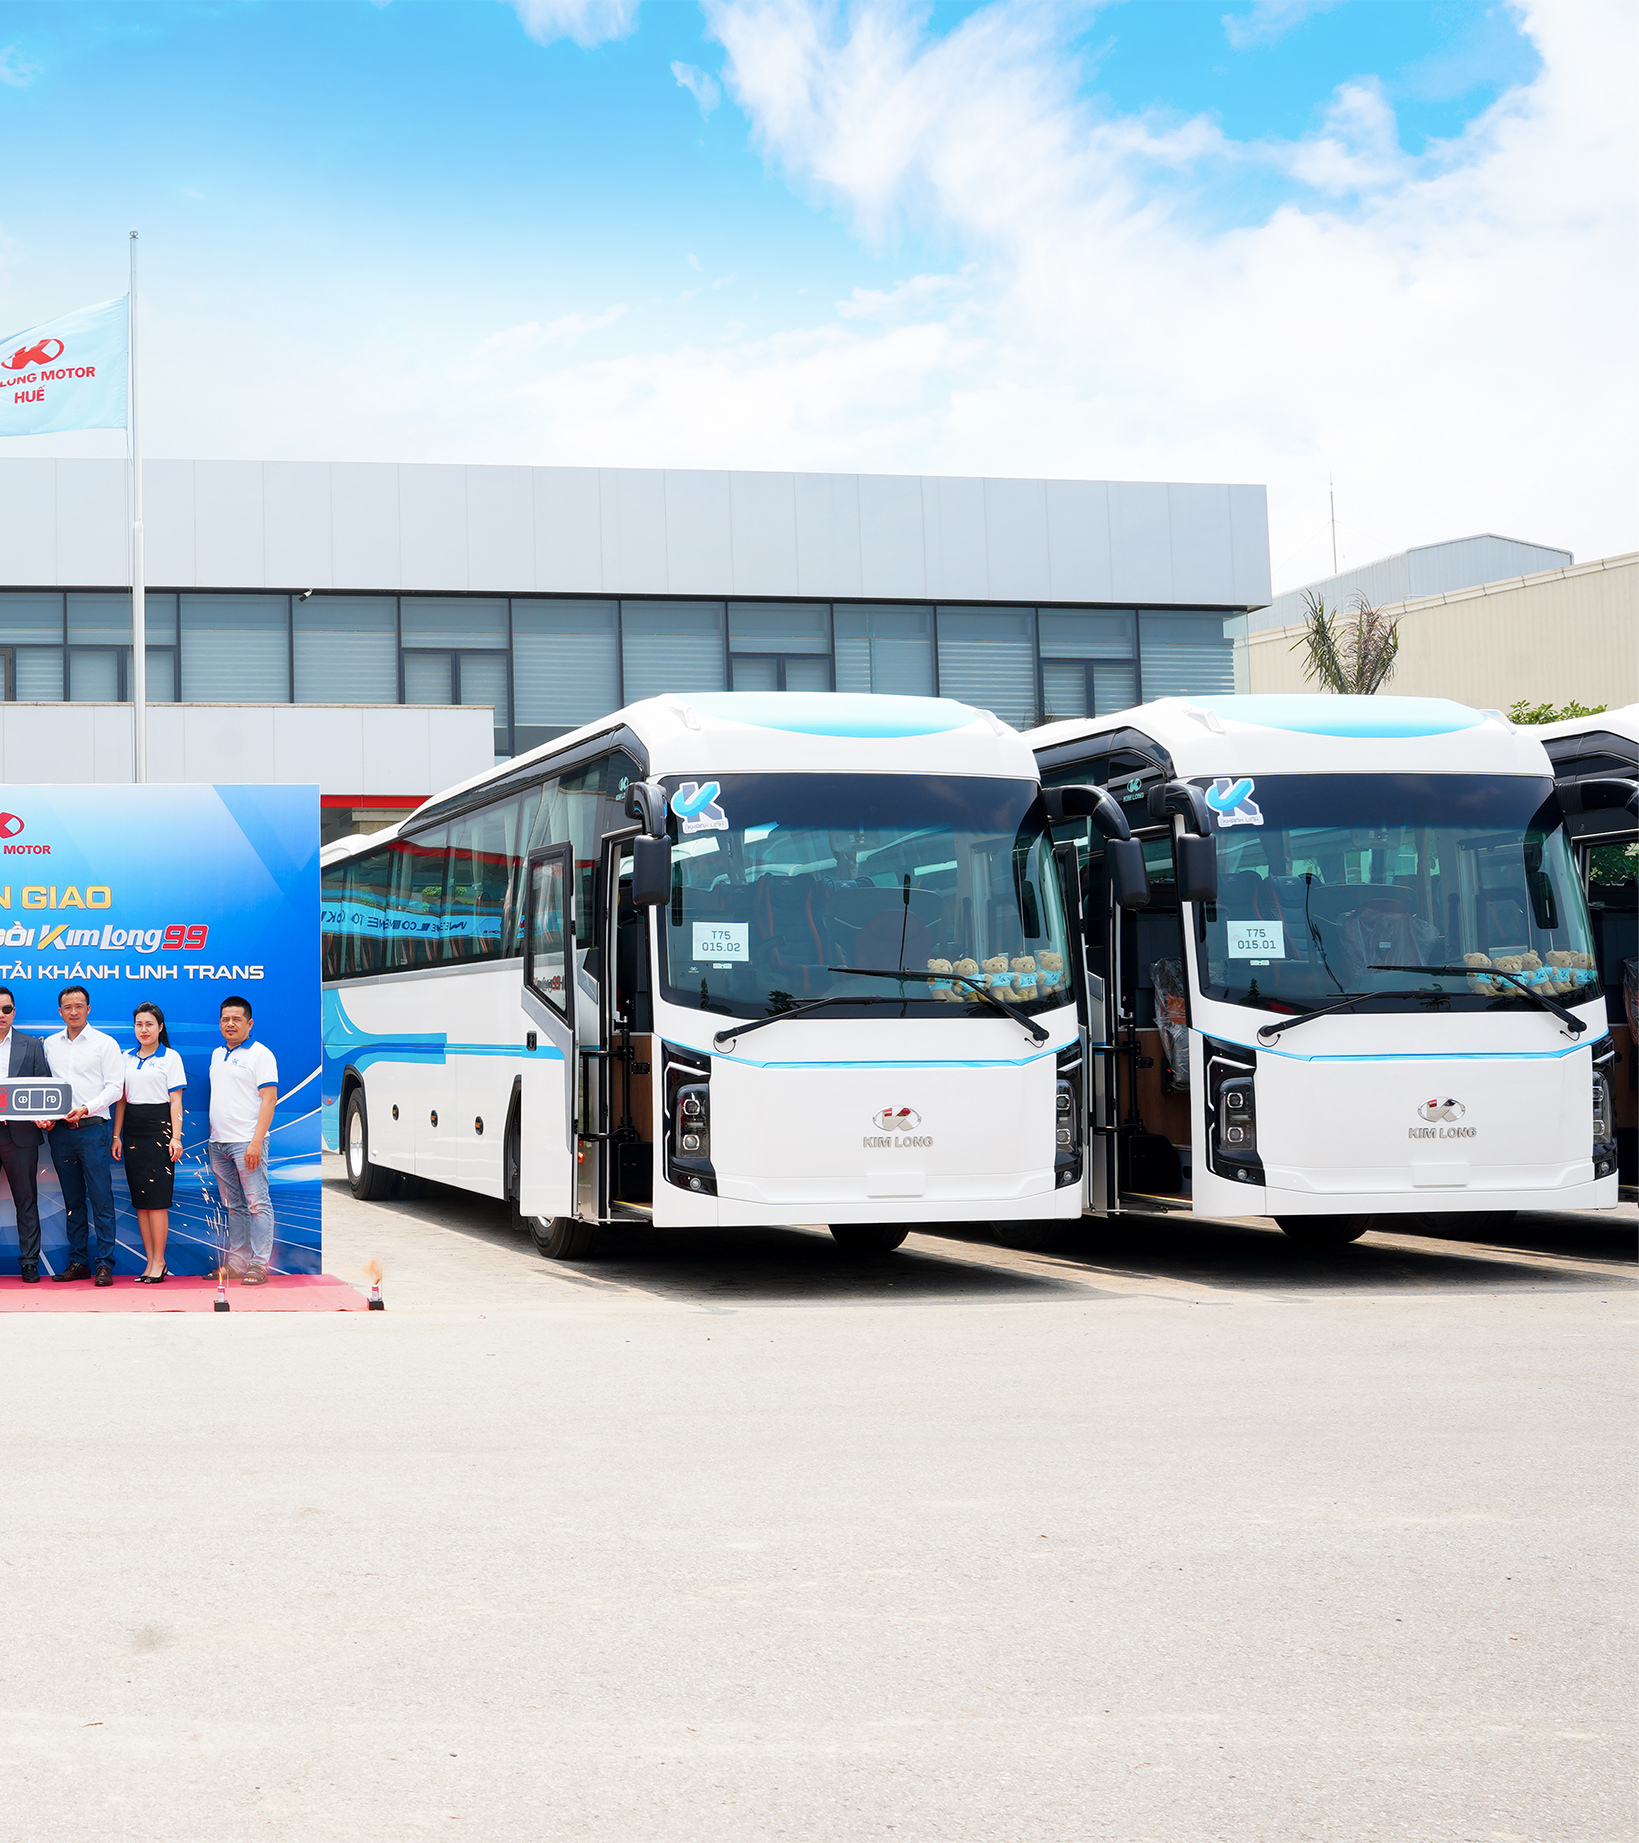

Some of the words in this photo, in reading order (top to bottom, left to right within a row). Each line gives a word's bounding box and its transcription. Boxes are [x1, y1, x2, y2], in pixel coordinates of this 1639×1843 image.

[0, 372, 38, 389] LONG
[41, 366, 96, 382] MOTOR
[14, 384, 46, 404] HUẾ
[3, 845, 51, 855] MOTOR
[21, 885, 112, 909] GIAO
[711, 930, 731, 940] T75
[1246, 928, 1266, 938] T75
[702, 942, 741, 952] 015.02
[1237, 940, 1276, 950] 015.01
[38, 960, 119, 980] KHÁNH
[125, 965, 178, 980] LINH
[183, 965, 265, 980] TRANS
[1408, 1127, 1437, 1138] KIM
[1439, 1127, 1477, 1138] LONG
[863, 1136, 892, 1148] KIM
[895, 1135, 934, 1147] LONG
